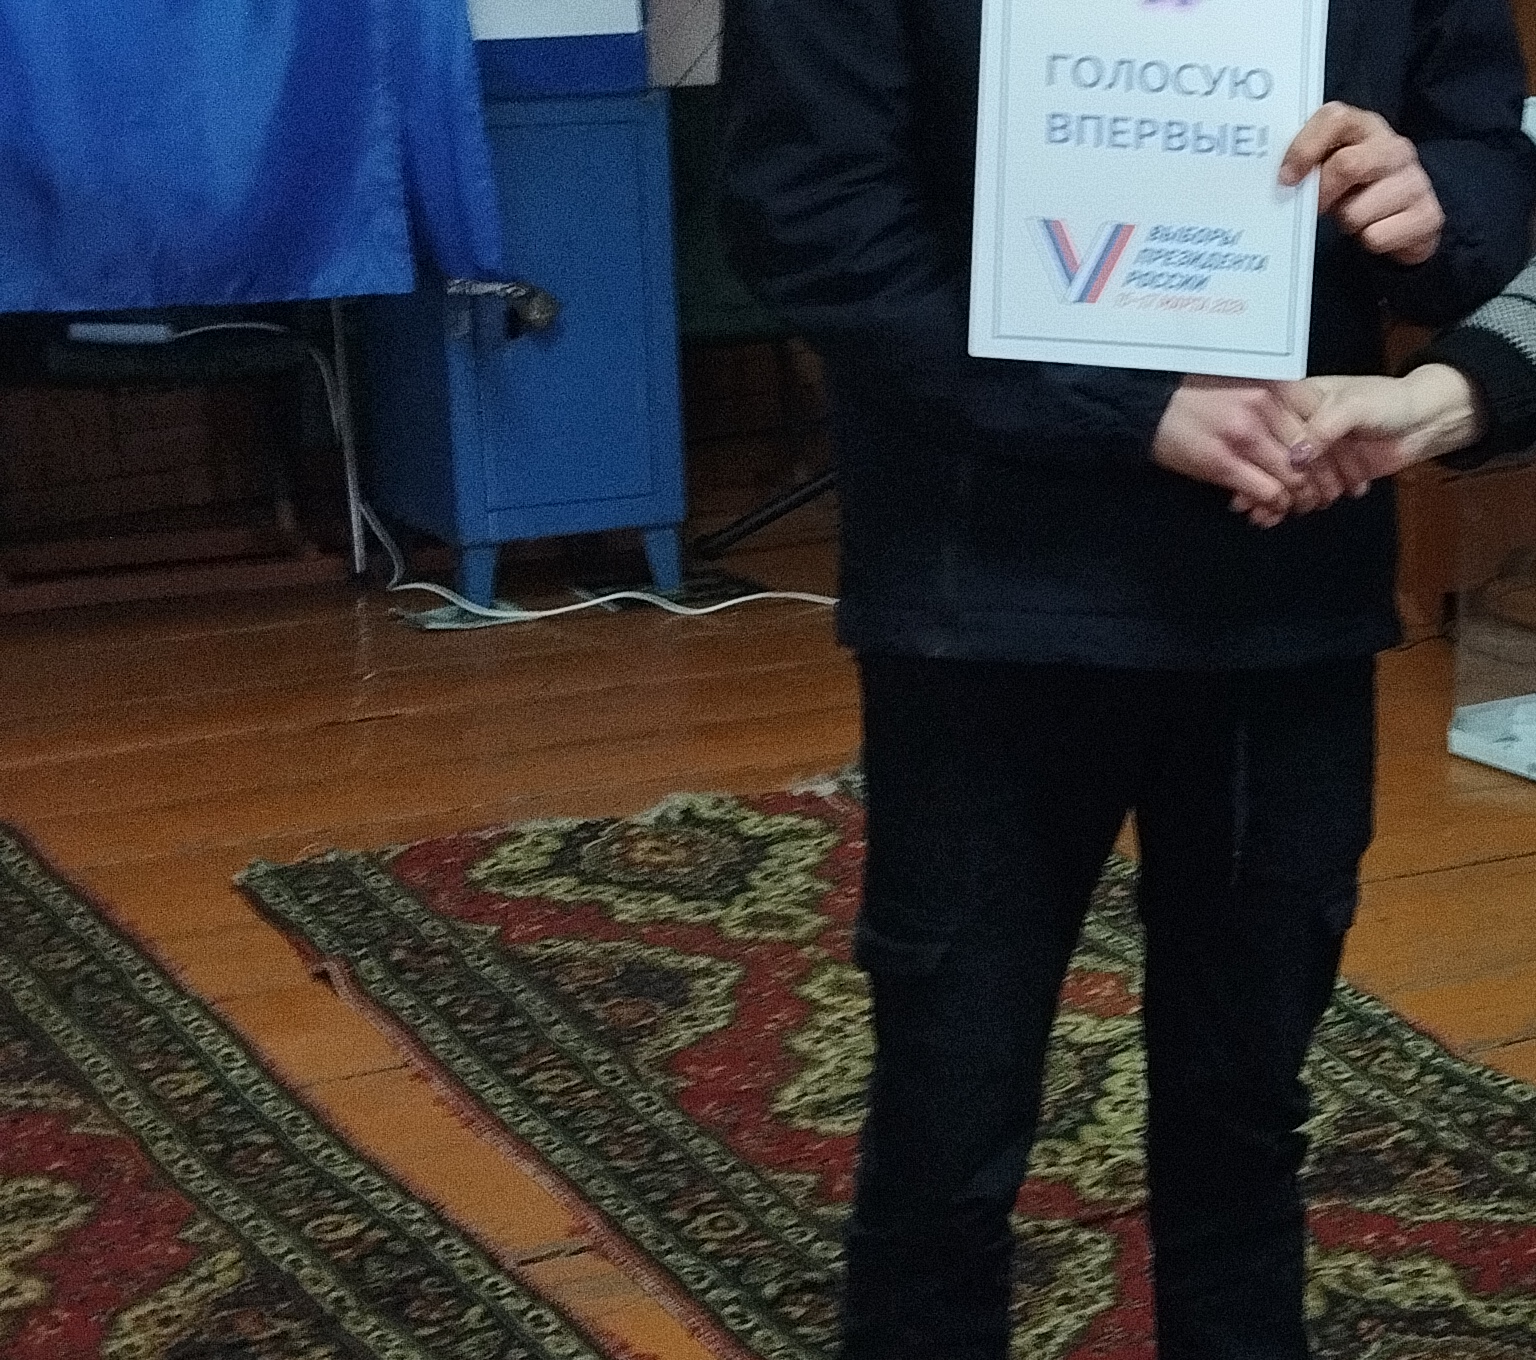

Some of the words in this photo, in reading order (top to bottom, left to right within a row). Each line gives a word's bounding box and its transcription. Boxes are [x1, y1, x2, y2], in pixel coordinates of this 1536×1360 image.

[1045, 53, 1275, 100] ГОЛОСУЮ
[1045, 111, 1270, 158] ВПЕРВЫЕ!
[1145, 224, 1245, 246] ВЫБОРЫ
[1133, 248, 1270, 272] ПРЕЗИДЕНТА
[1122, 270, 1211, 291] РОССИИ
